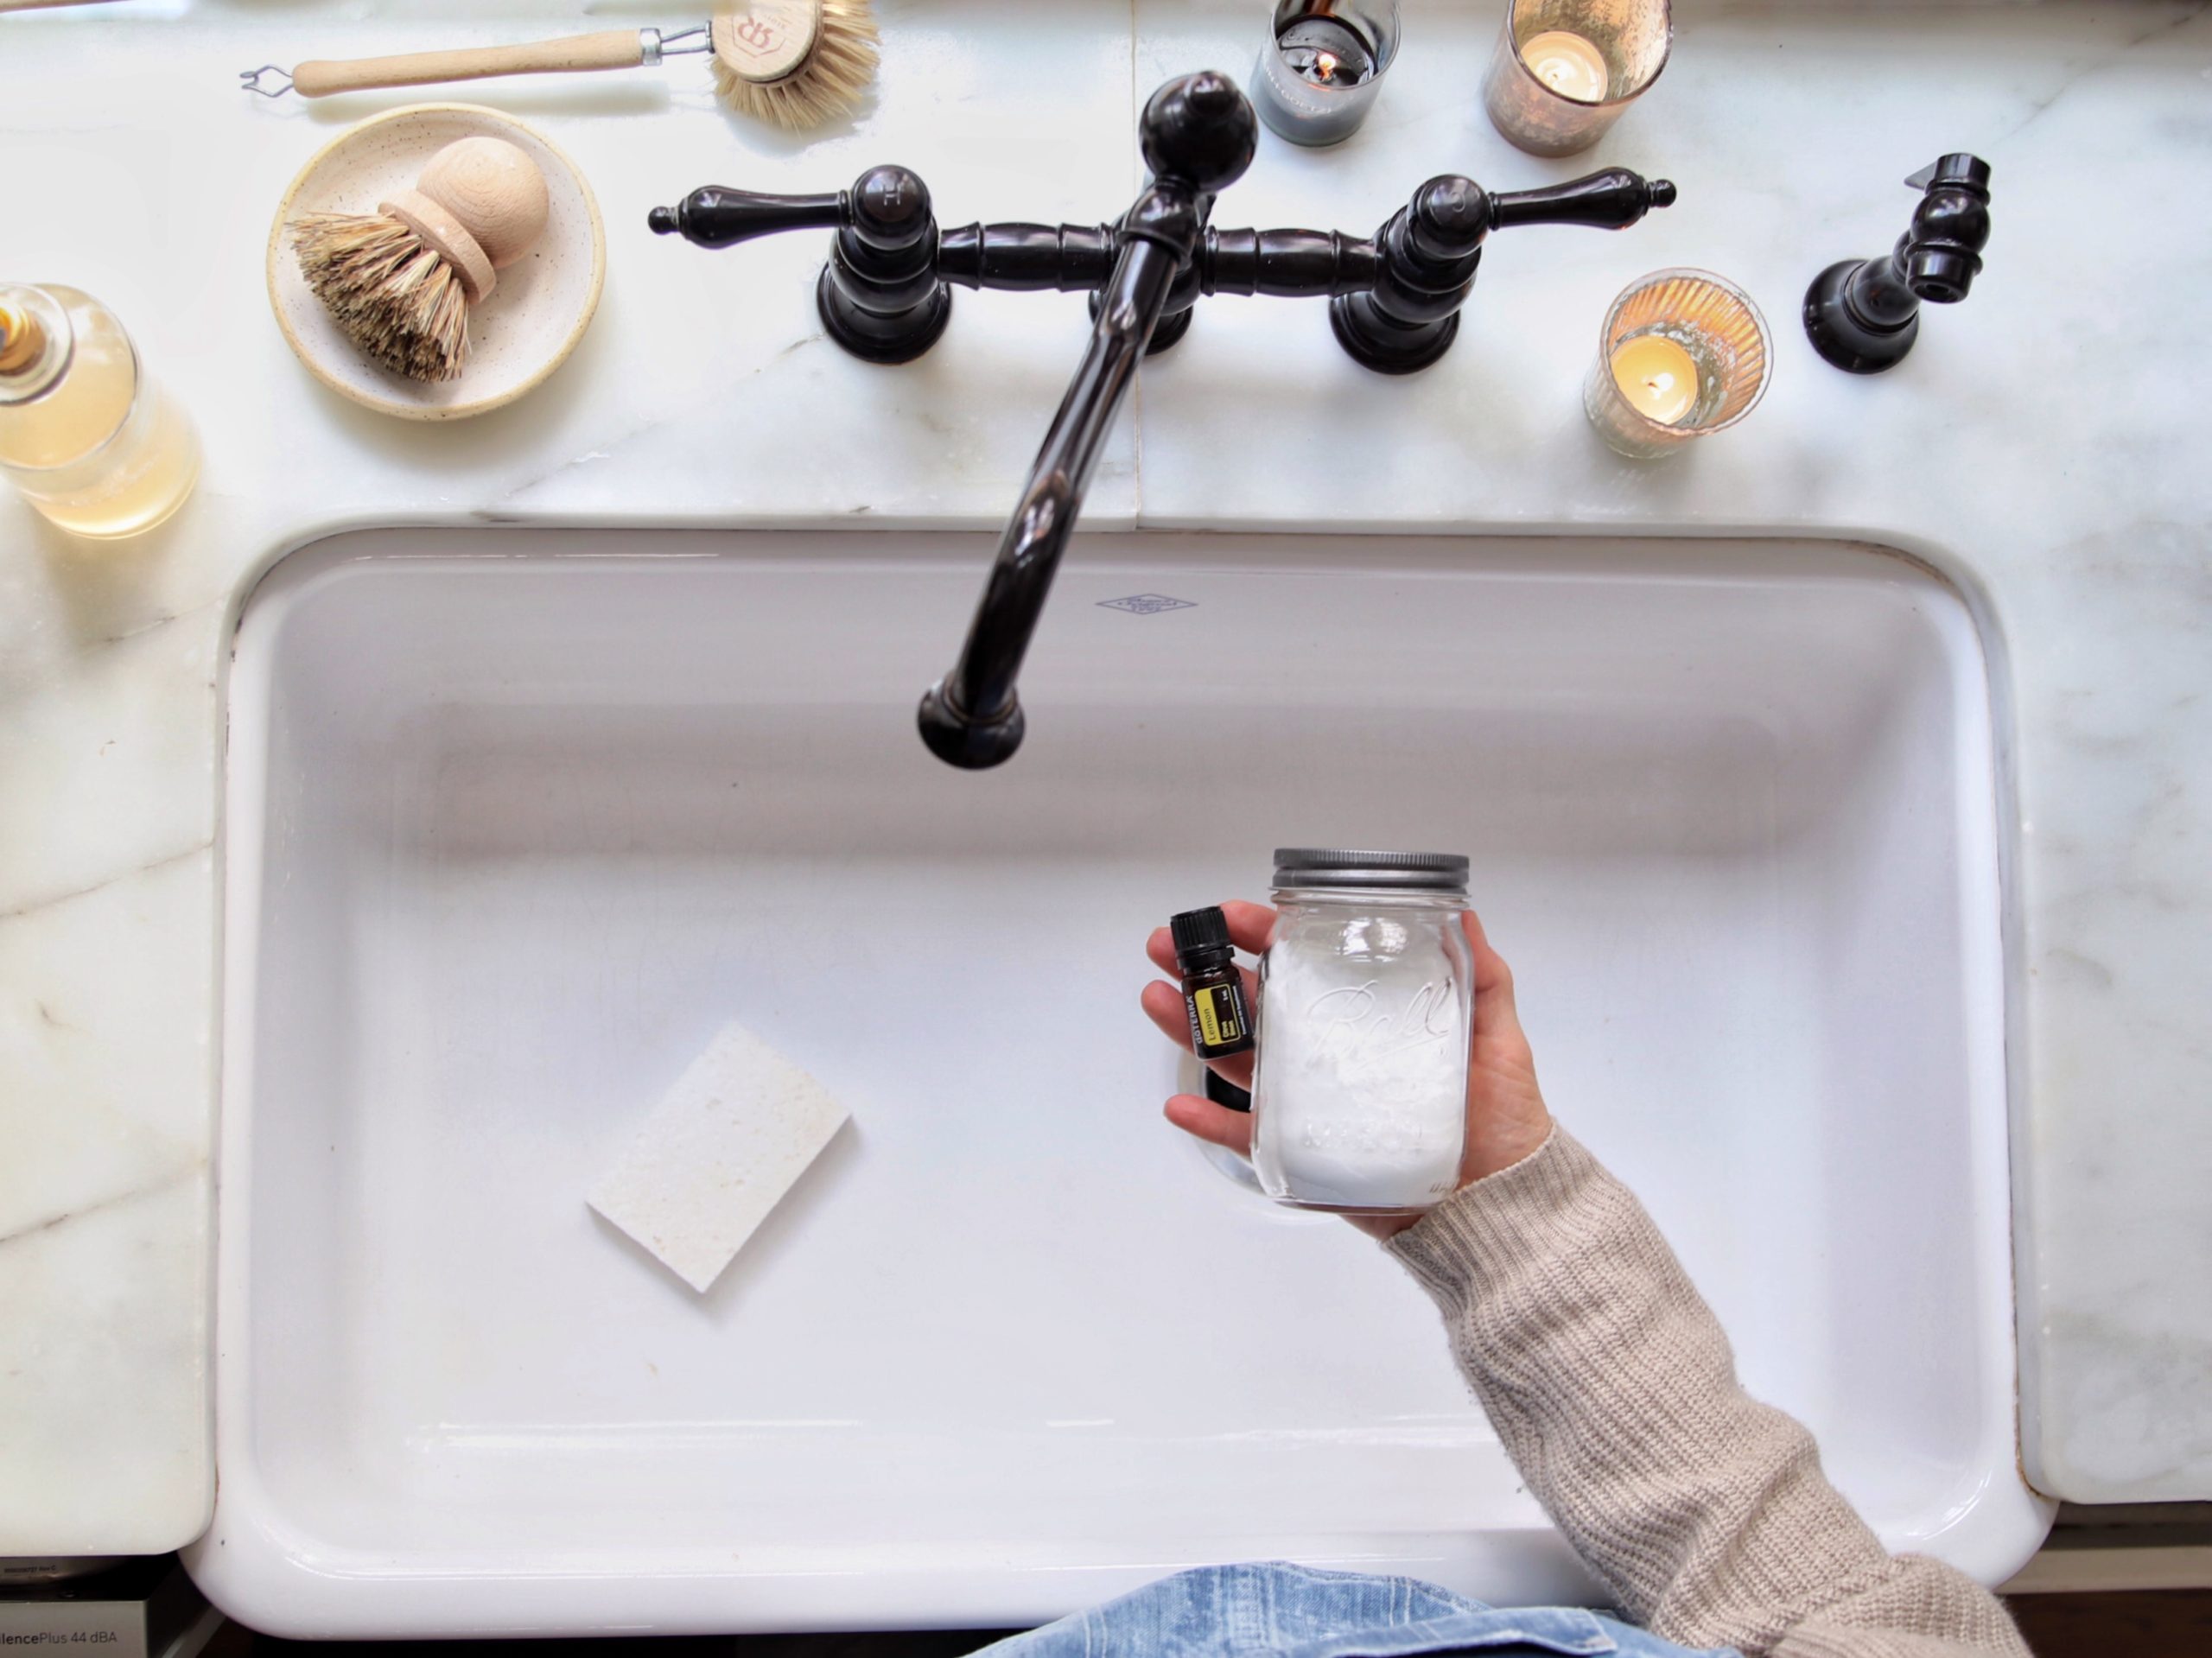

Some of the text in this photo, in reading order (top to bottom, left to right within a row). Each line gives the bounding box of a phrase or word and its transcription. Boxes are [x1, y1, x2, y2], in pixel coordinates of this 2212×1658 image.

[882, 182, 903, 206] H
[1203, 1008, 1216, 1041] Lemon
[0, 1631, 118, 1644] lencePlus 44 dBA
